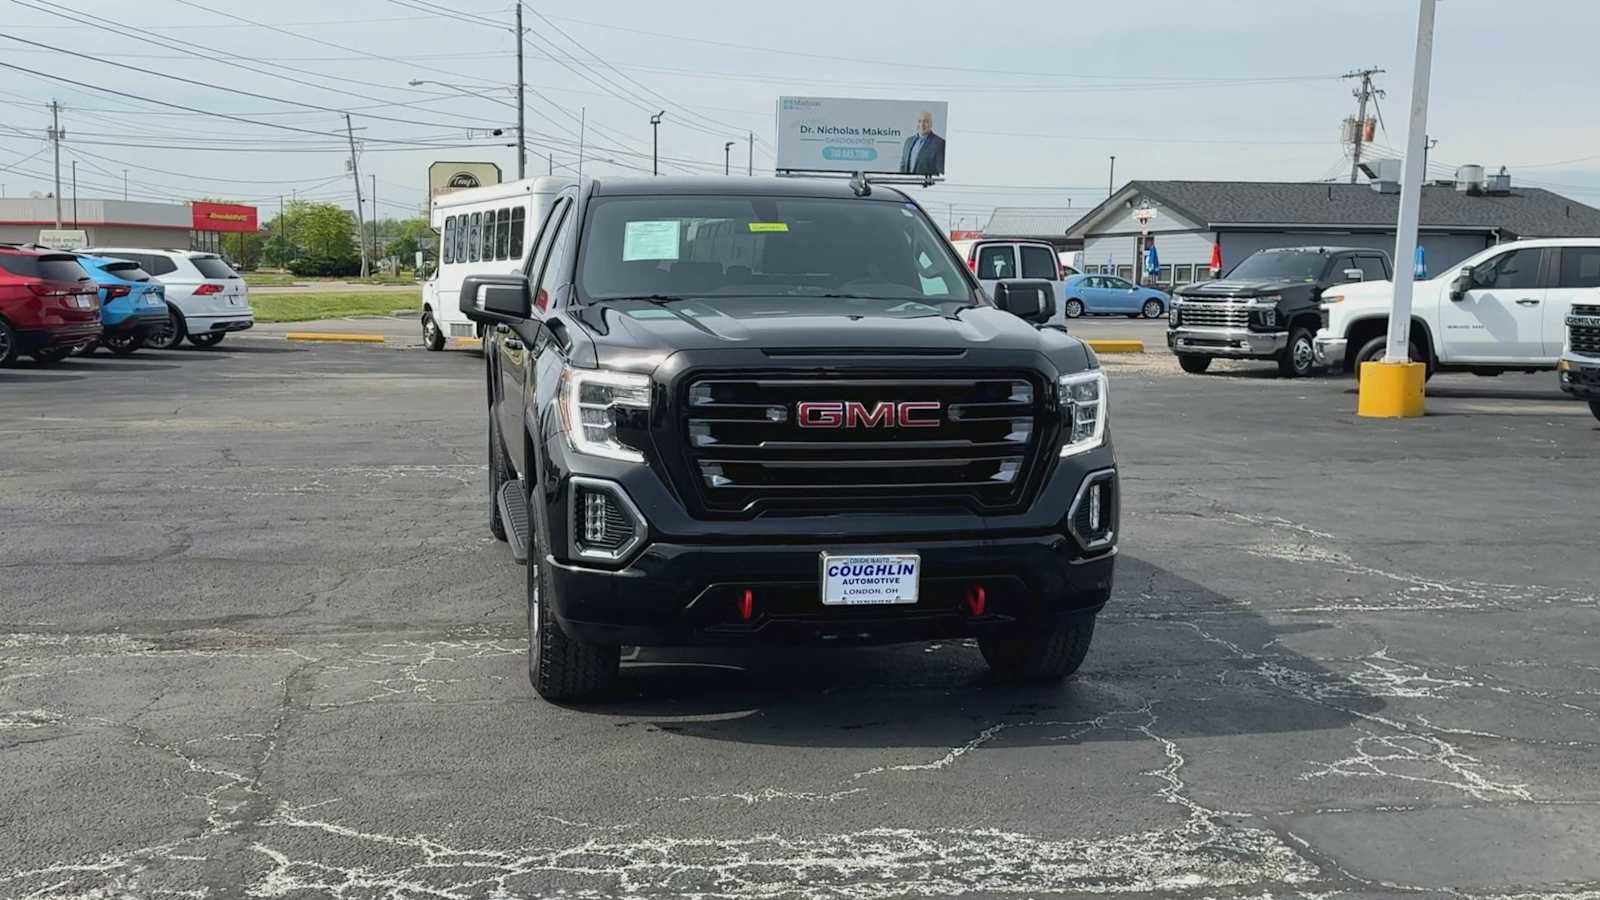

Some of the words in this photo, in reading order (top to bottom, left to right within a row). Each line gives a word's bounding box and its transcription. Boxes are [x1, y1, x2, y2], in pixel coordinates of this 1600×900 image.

[800, 125, 815, 134] Dr.
[817, 126, 860, 136] Nicholas
[862, 128, 901, 137] Maksim
[798, 401, 941, 429] GMC
[828, 564, 915, 577] COUGHLIN
[842, 577, 901, 586] AUTOMOTIVE
[885, 587, 899, 595] OH
